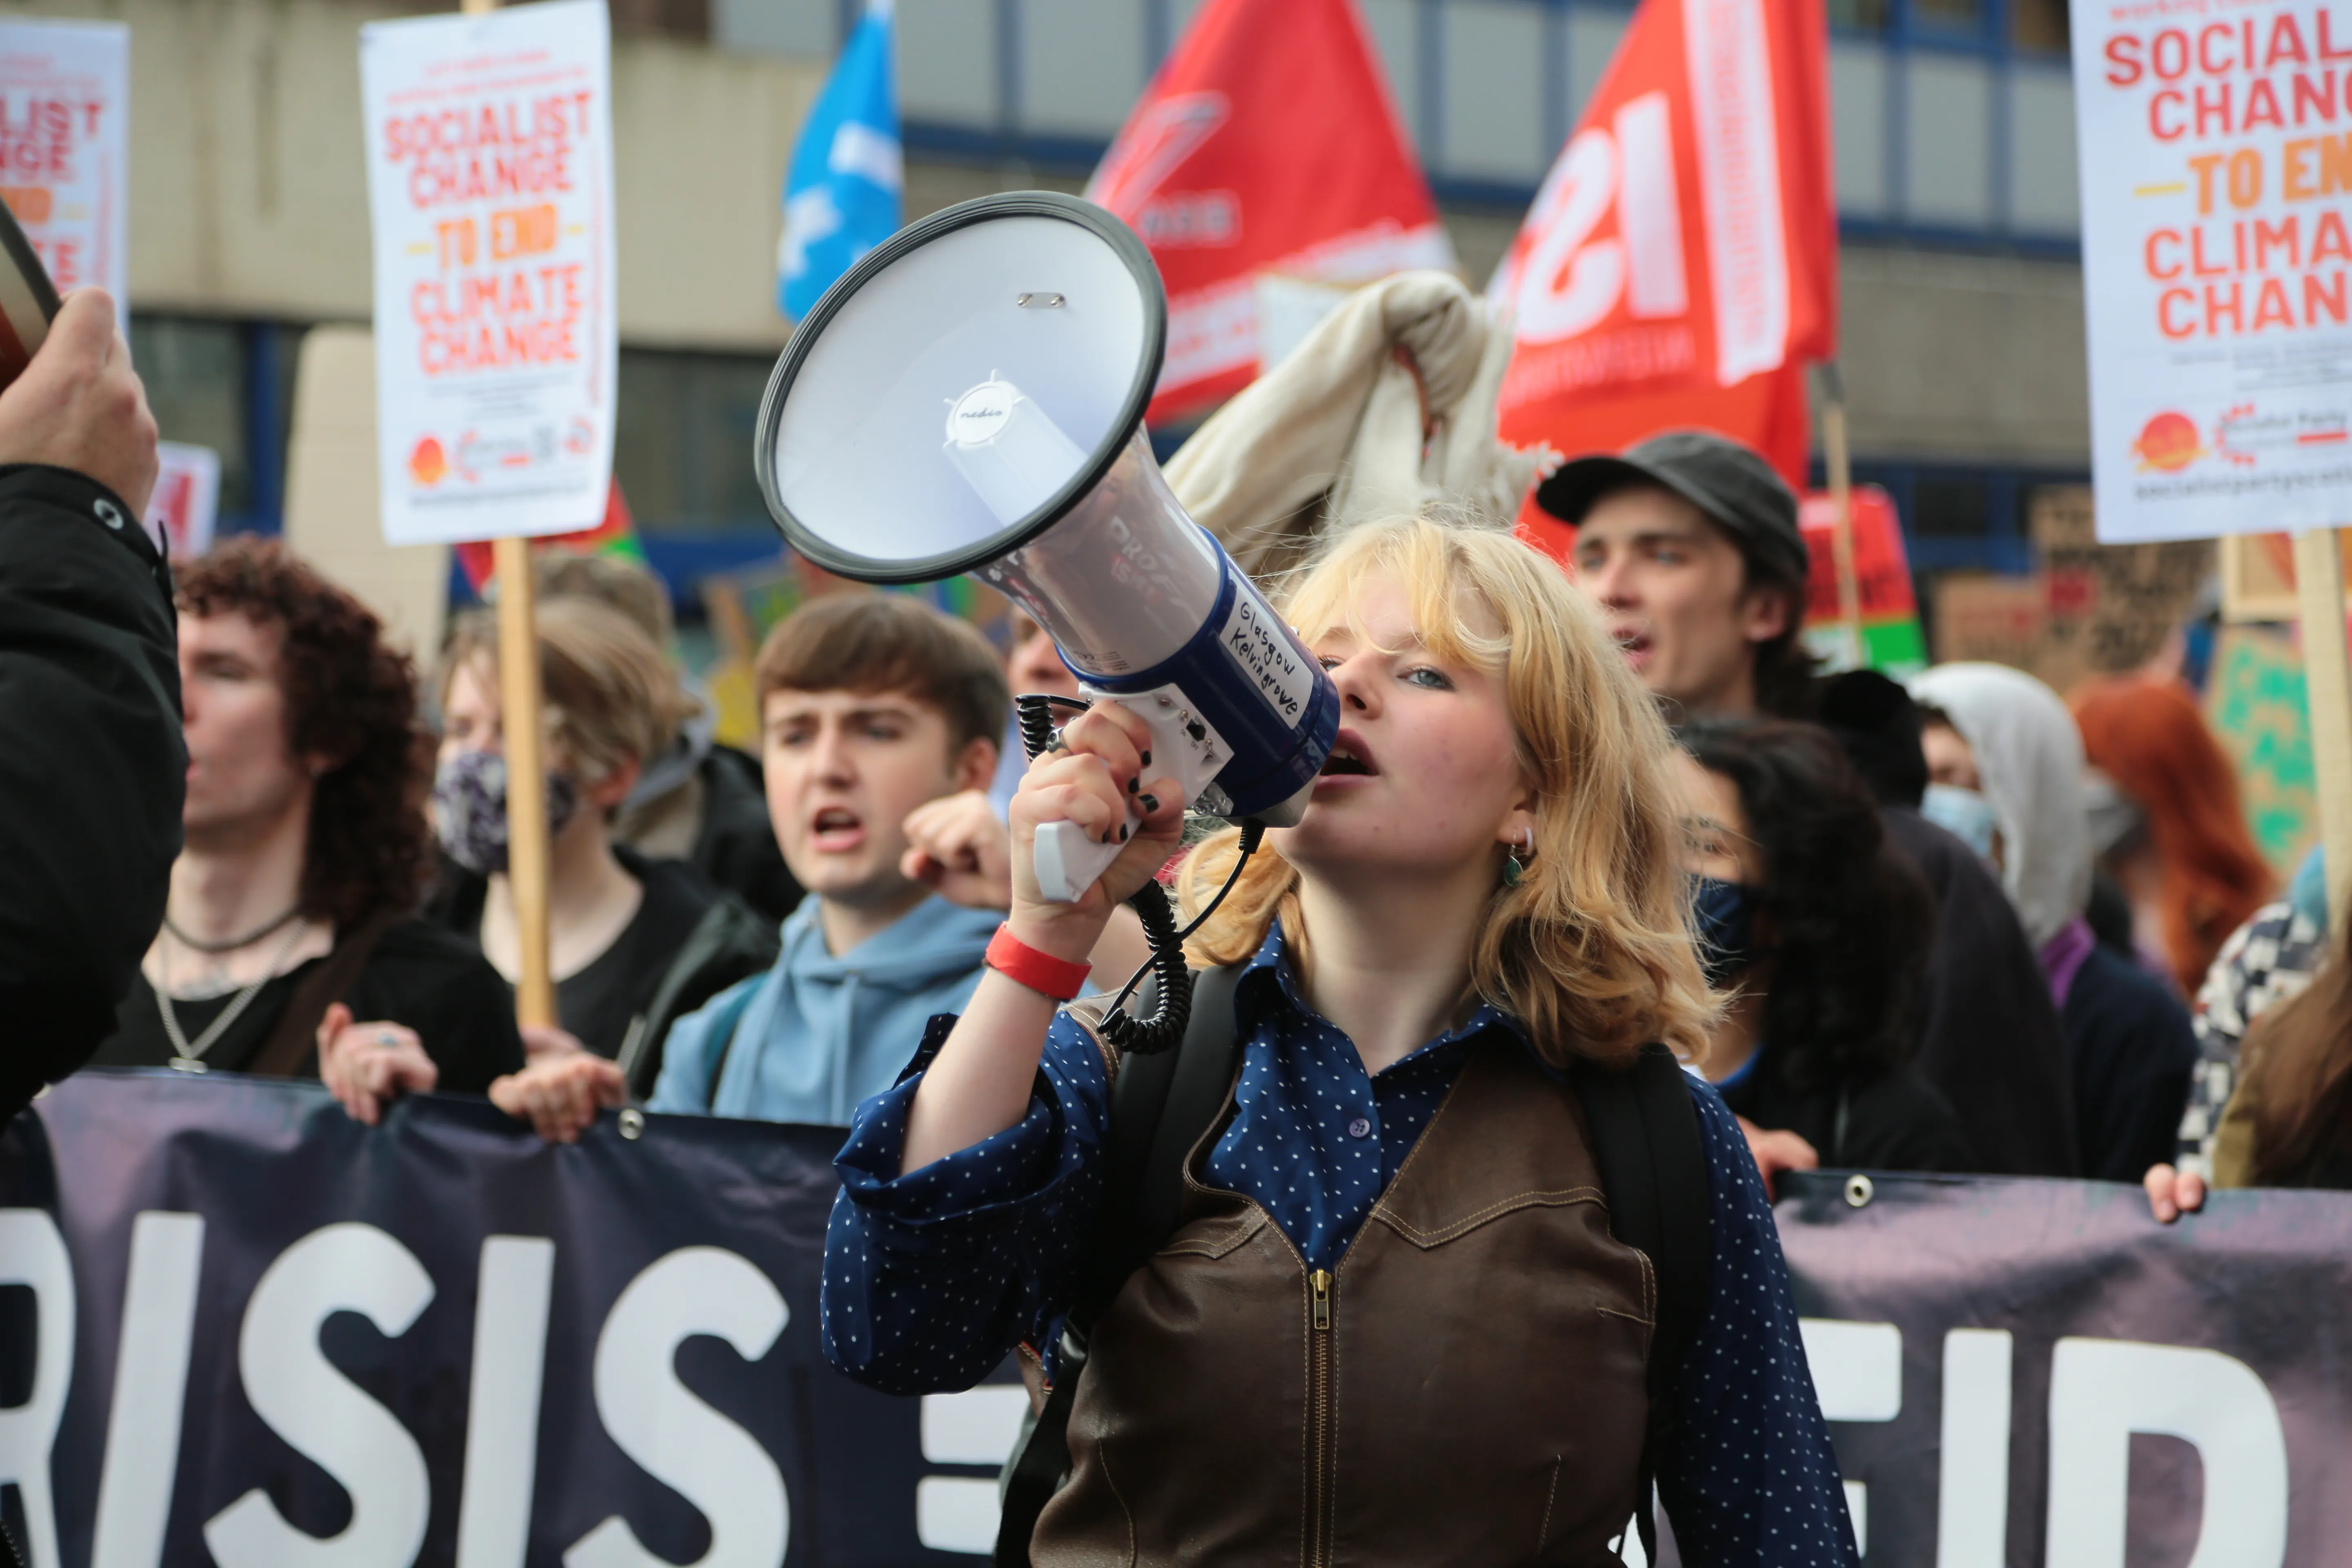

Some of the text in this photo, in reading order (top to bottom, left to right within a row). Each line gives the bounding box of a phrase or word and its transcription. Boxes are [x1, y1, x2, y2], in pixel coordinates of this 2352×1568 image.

[2104, 8, 2352, 87] SOCIAL
[384, 90, 592, 163] SOCIALIST
[408, 145, 572, 209] CHANGE
[2188, 147, 2263, 216] TO
[436, 203, 557, 270] TO END
[2143, 209, 2352, 281] CLIMA
[412, 263, 581, 325] CLIMATE
[2158, 271, 2346, 341] CHAN
[420, 318, 577, 375] CHANGE
[1241, 601, 1295, 675] Glasgow
